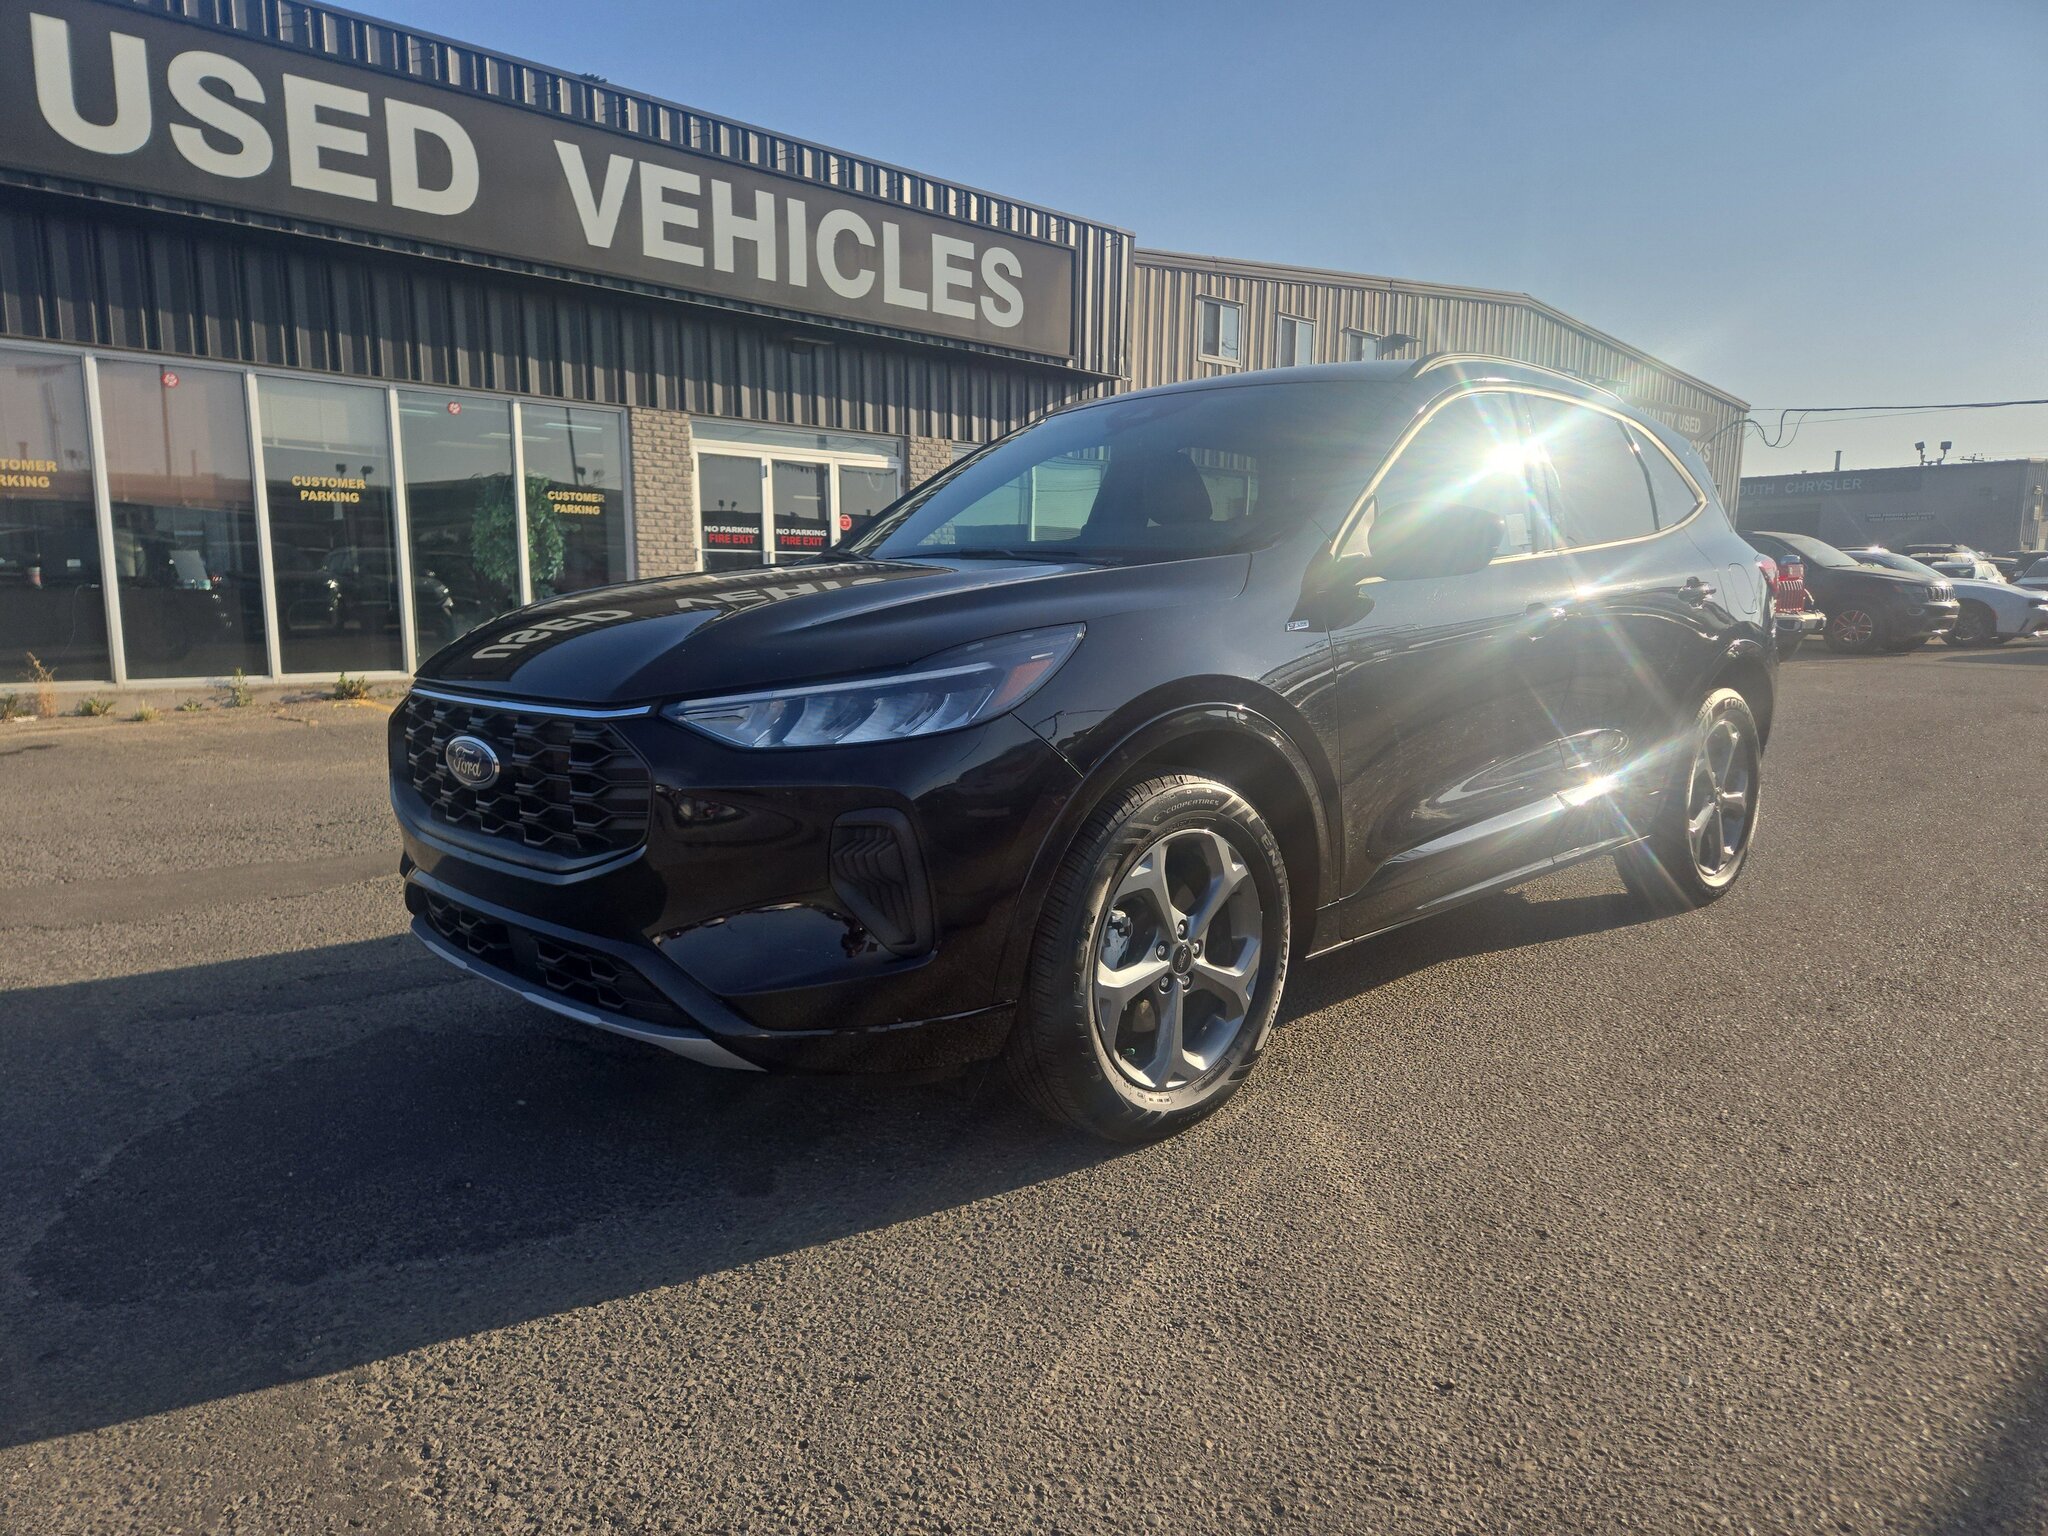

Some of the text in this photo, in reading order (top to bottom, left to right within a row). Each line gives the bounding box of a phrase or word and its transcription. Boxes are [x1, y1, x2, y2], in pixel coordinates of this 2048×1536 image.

[29, 12, 1024, 328] USED VEHICLES
[1679, 414, 1701, 433] USED
[291, 475, 366, 490] CUSTOMER
[1785, 478, 1861, 494] CHRYSLER
[300, 489, 360, 503] PARKING
[547, 490, 605, 503] CUSTOMER
[553, 503, 600, 515] PARKING
[704, 525, 759, 534] NO PARKING
[709, 534, 755, 544] FIRE EXIT
[781, 536, 823, 547] FIRE EXIT
[453, 746, 482, 777] Ford
